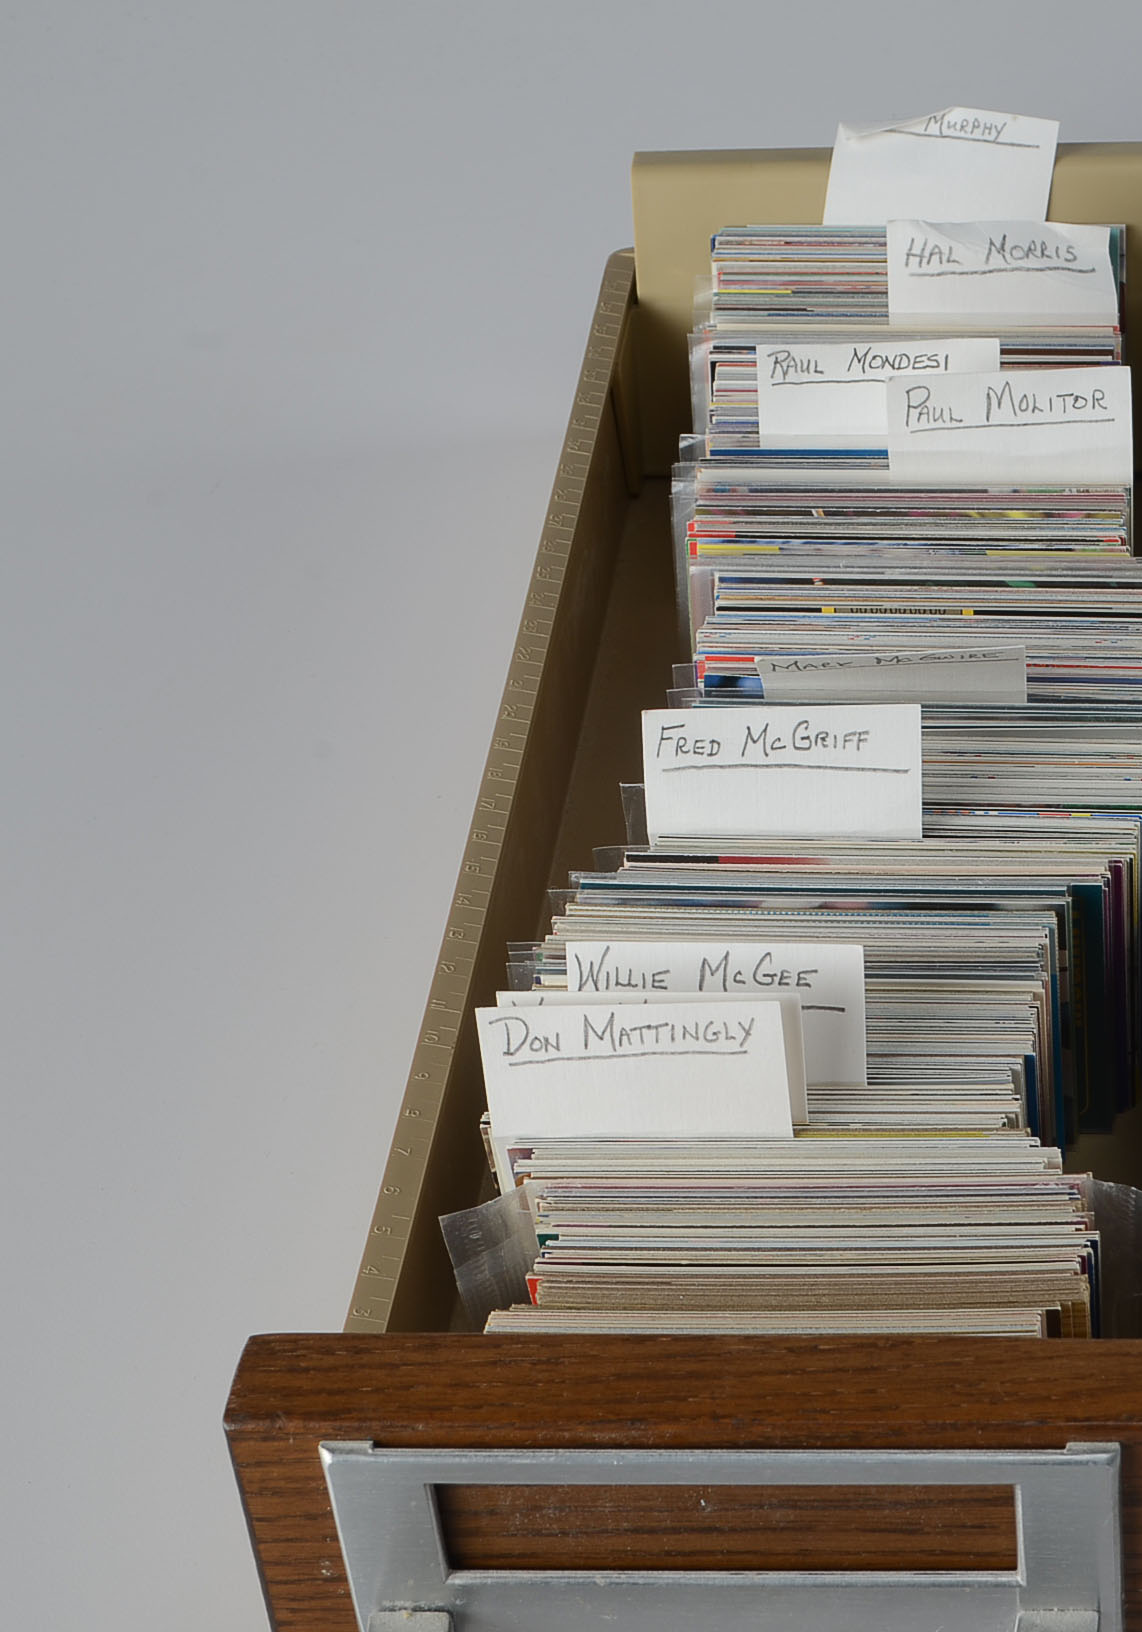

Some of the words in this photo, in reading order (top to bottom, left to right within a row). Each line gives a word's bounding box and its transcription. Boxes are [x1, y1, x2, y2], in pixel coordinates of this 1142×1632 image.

[924, 114, 1007, 142] MURPHY
[905, 238, 964, 268] HAL
[985, 233, 1077, 265] MORRIS
[767, 350, 824, 379] RAUL
[847, 347, 949, 373] MONDESI
[905, 386, 963, 427] PAUL
[986, 381, 1107, 422] MOLITOR
[771, 660, 853, 673] MARK
[657, 724, 721, 759] FRED
[574, 946, 671, 992] WILLIE
[488, 1016, 561, 1058] DON
[583, 1012, 755, 1052] MATTINGLY
